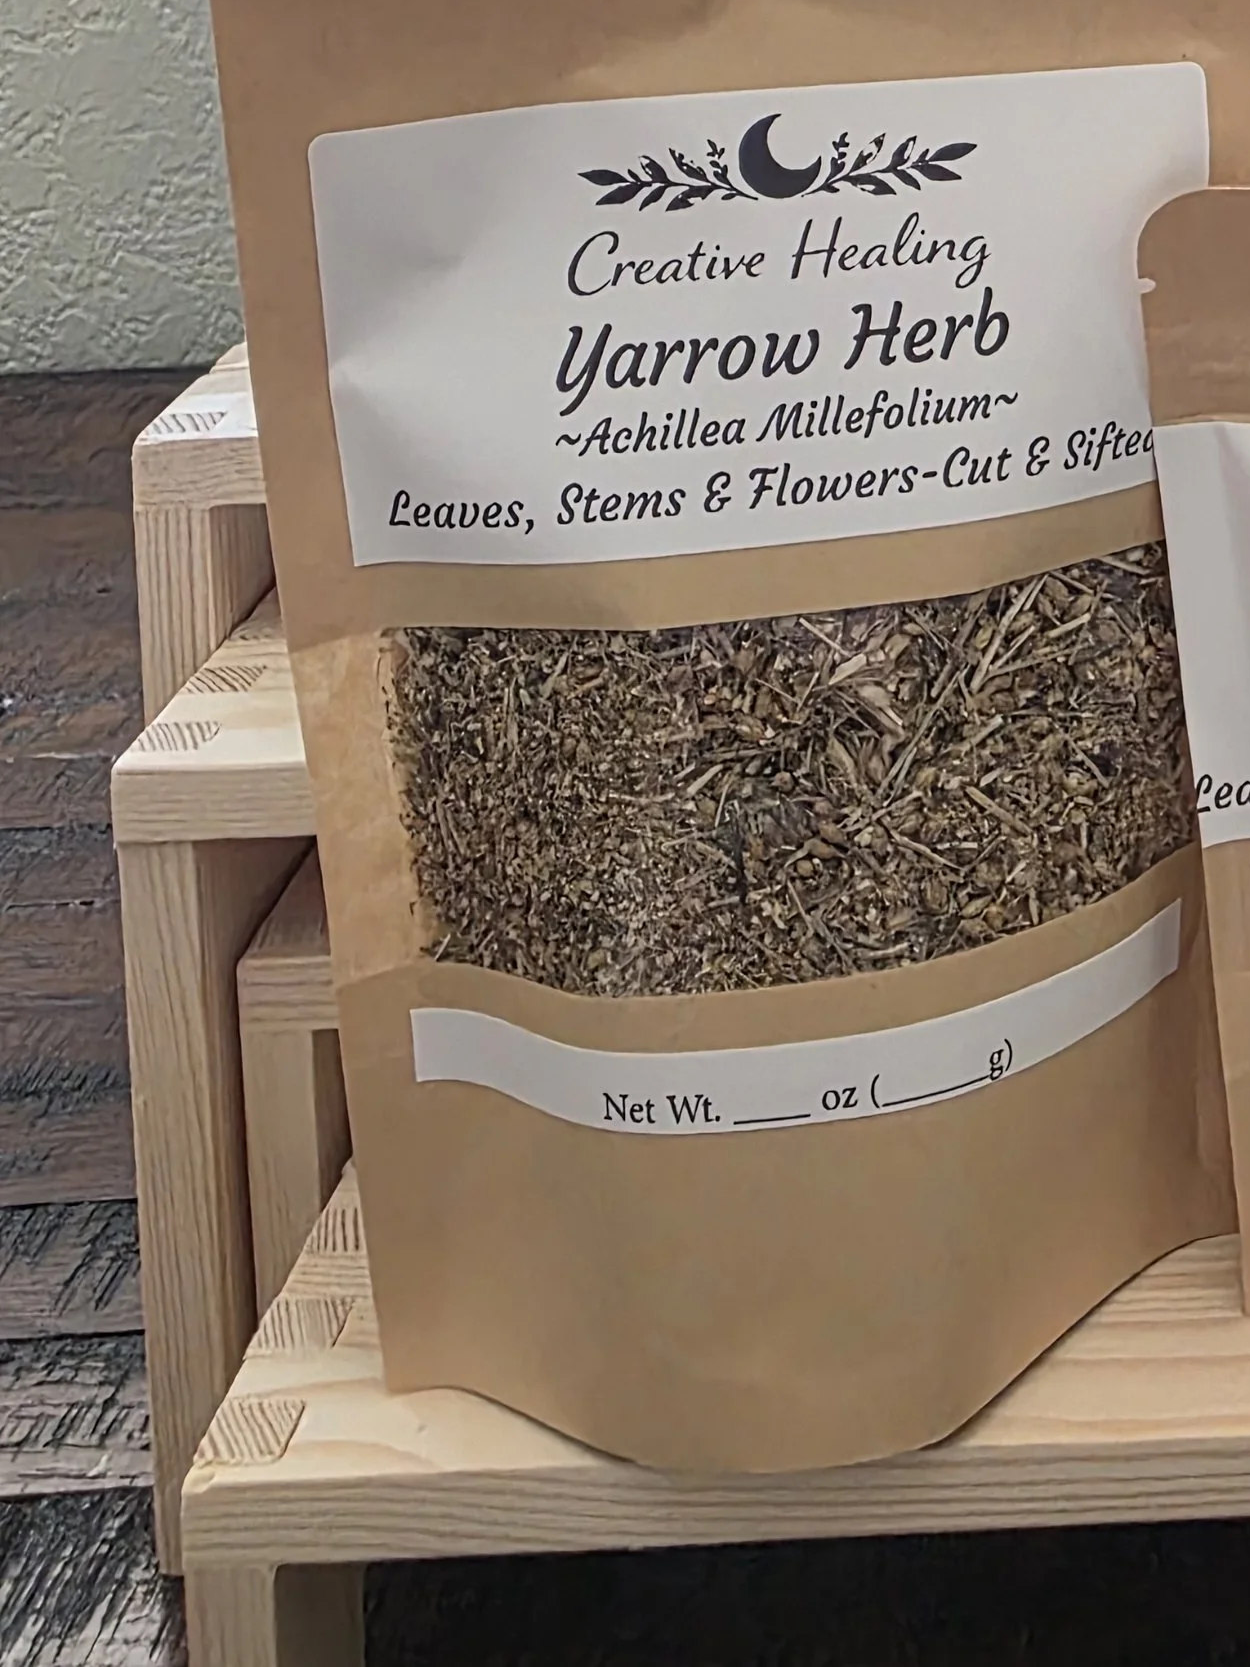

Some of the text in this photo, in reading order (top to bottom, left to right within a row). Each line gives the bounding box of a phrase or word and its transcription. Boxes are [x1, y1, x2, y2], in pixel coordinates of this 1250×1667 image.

[568, 212, 991, 296] Creative Healing
[556, 286, 1009, 421] Yarrow Herb
[389, 490, 534, 534] Leaves,
[557, 483, 686, 525] Stems
[704, 471, 731, 513] &
[749, 446, 1012, 509] Flowers-Cut
[1026, 436, 1050, 476] &
[603, 1093, 656, 1124] Net
[666, 1094, 720, 1124] Wt.
[822, 1087, 858, 1110] oz
